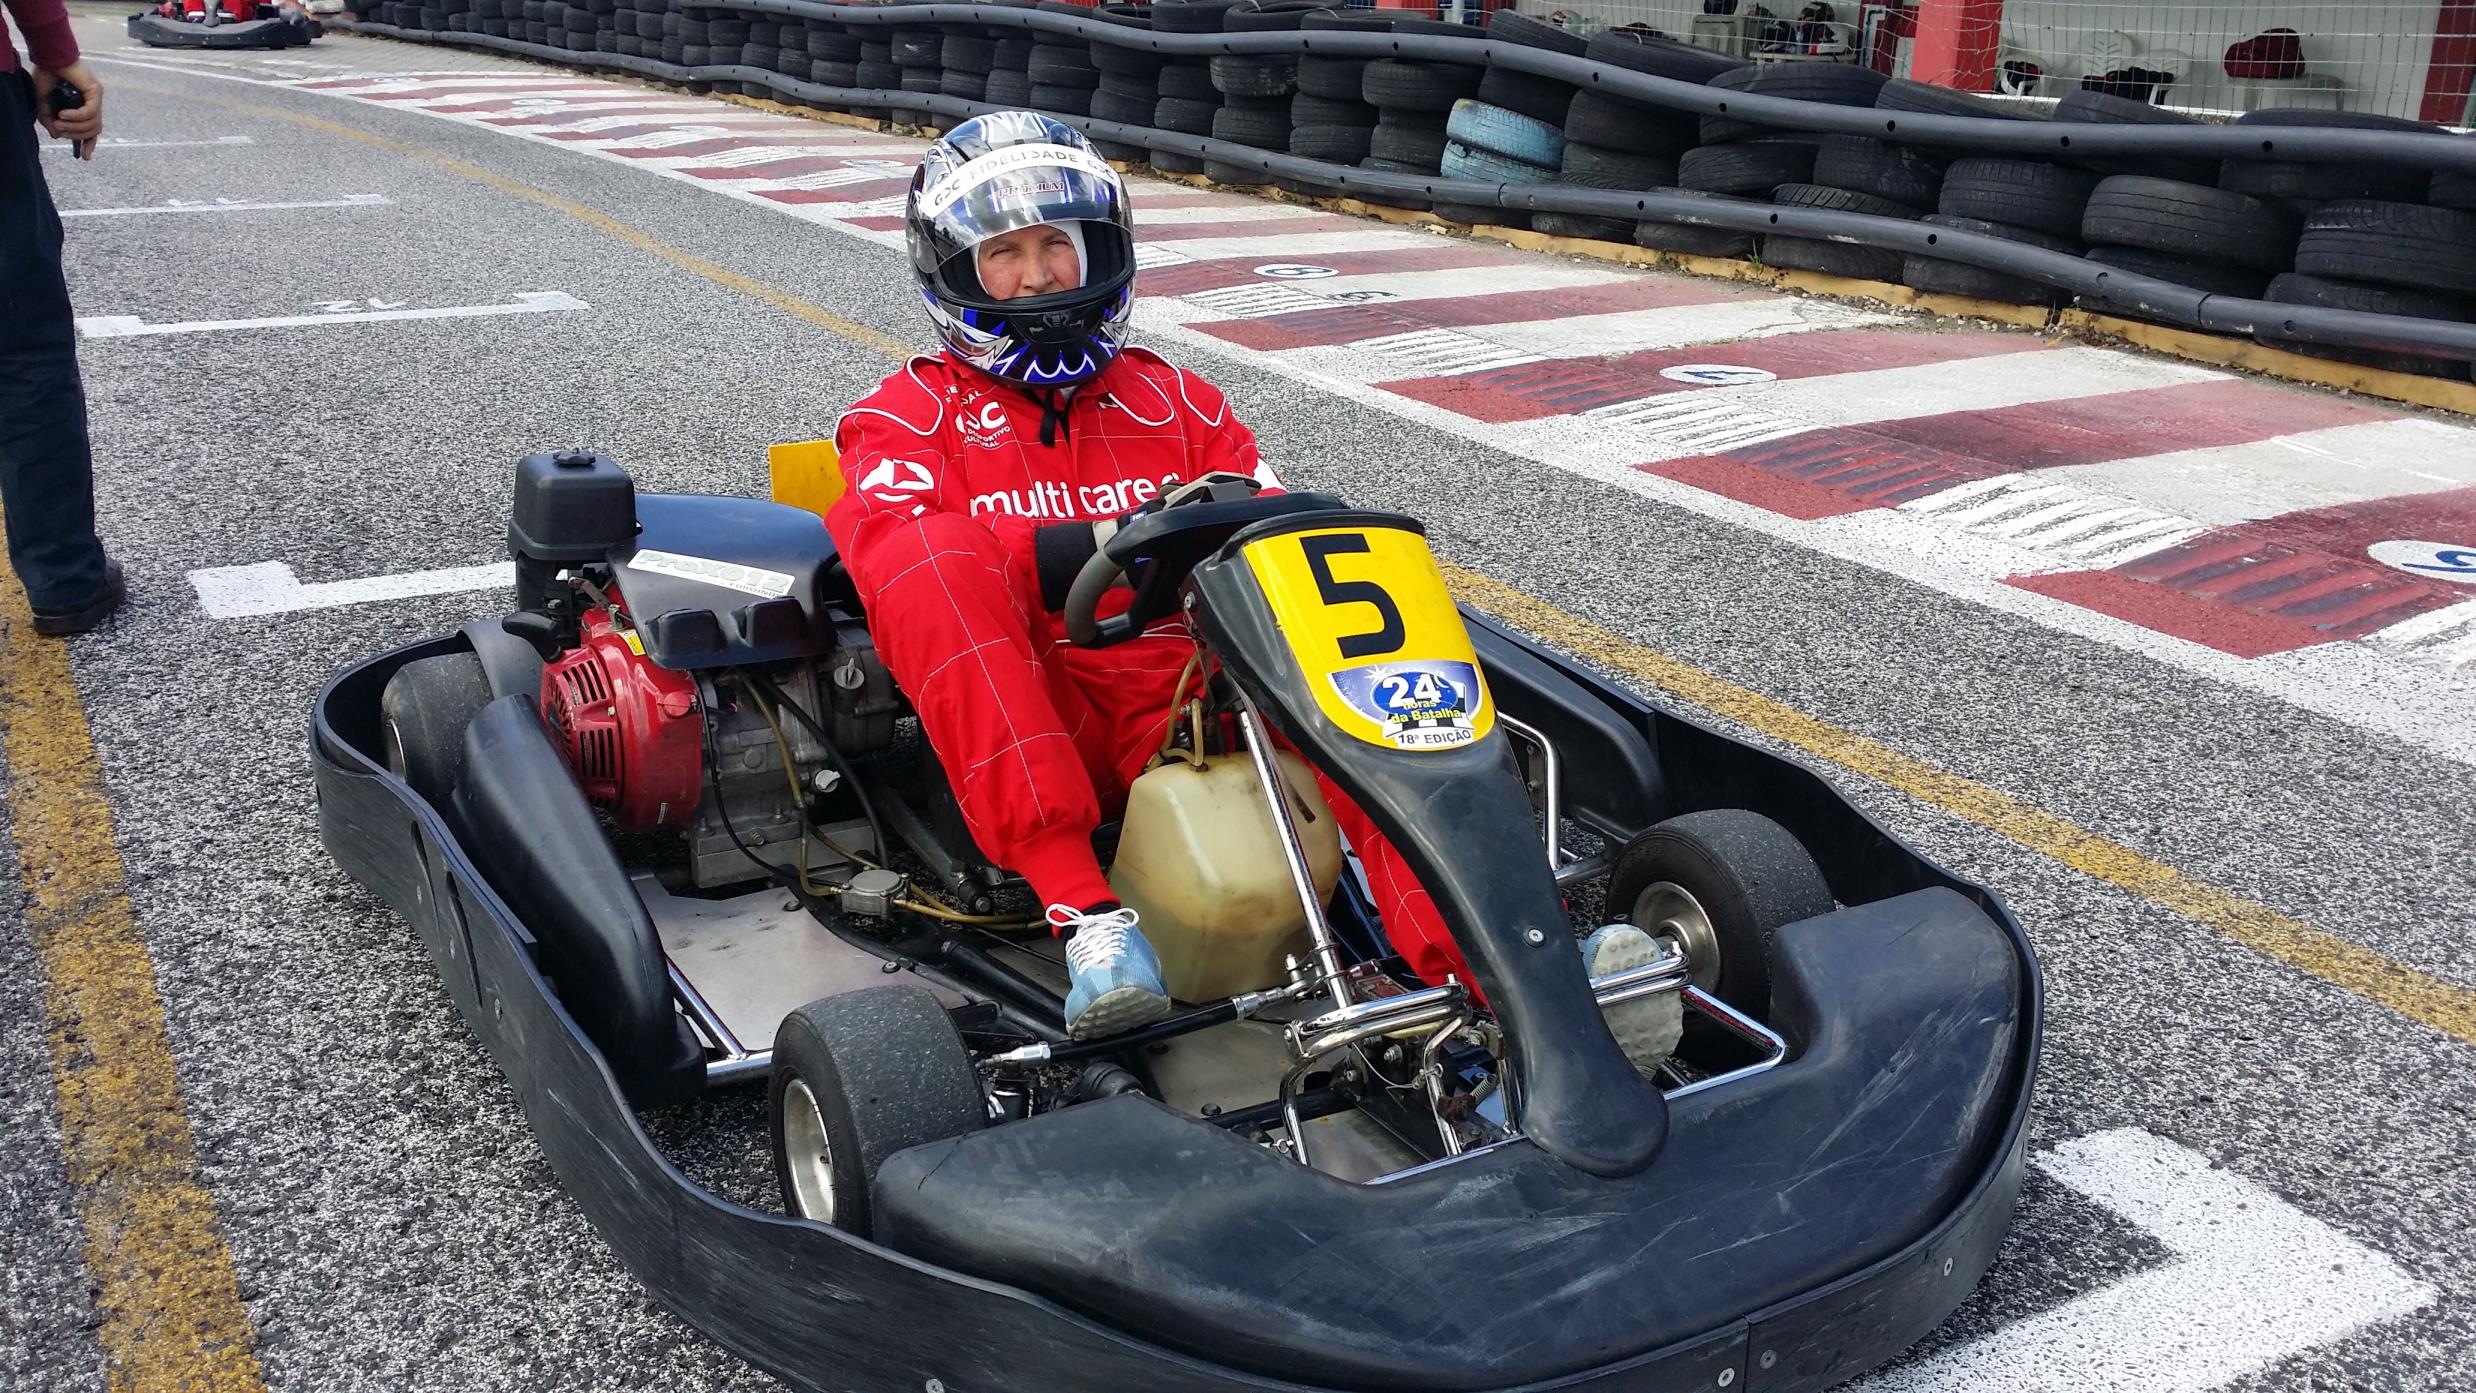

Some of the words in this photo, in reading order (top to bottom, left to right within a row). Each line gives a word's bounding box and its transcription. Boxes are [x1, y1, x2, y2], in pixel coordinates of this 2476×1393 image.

[970, 481, 1074, 518] multi
[1079, 478, 1156, 514] care
[1299, 533, 1406, 659] 5
[1382, 673, 1442, 708] 24
[1391, 712, 1409, 724] da
[1412, 707, 1461, 721] Batalha
[1425, 729, 1472, 744] EDIÇÃO
